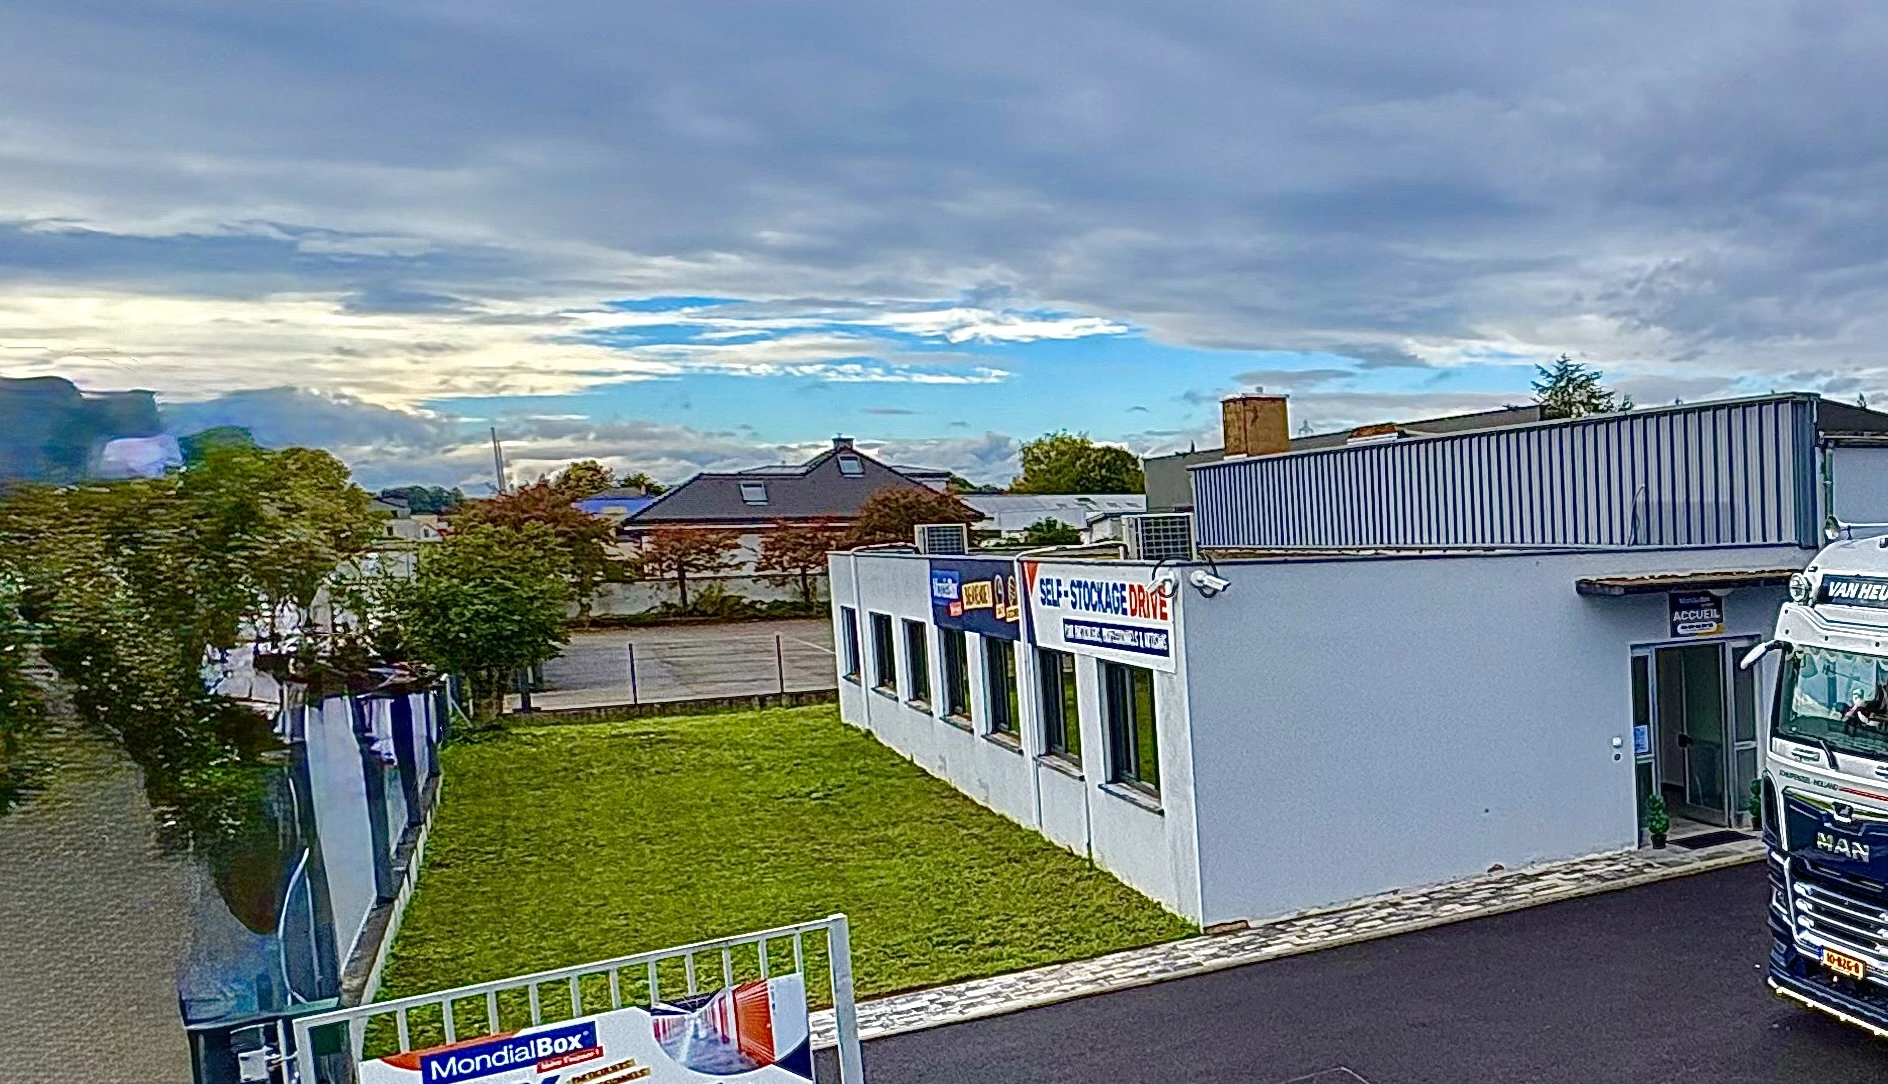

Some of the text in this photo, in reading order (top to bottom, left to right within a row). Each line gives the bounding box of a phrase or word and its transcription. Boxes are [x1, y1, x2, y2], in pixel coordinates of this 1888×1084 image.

[1129, 584, 1168, 620] DRIVE
[1829, 582, 1859, 598] VAN
[1673, 609, 1720, 621] ACCUEIL
[1817, 832, 1869, 863] MAN
[431, 1033, 583, 1080] MondialBox
